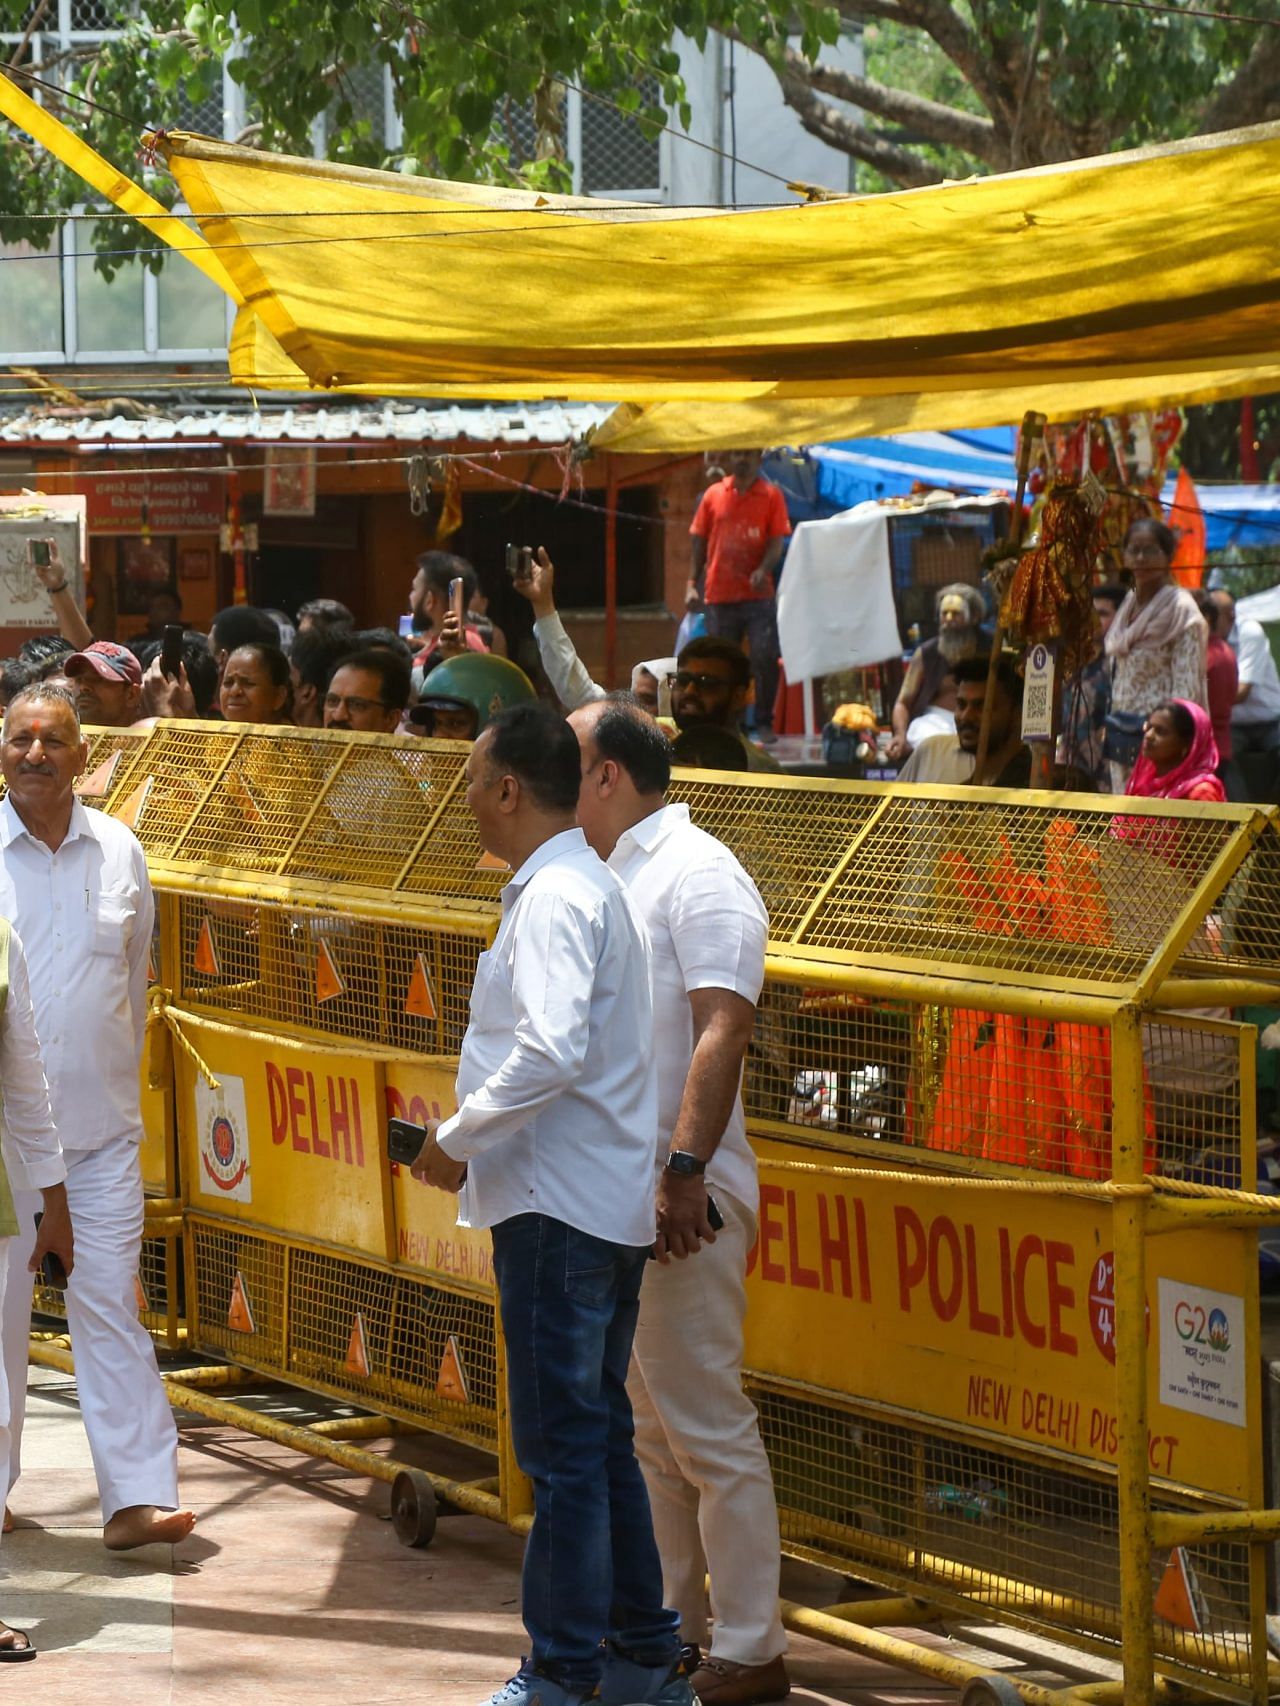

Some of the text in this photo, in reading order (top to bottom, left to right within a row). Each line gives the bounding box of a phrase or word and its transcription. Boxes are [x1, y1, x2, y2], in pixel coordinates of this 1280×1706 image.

[265, 1061, 365, 1168] DELHI
[399, 1228, 430, 1269] NEW
[435, 1237, 473, 1276] DELHI
[745, 1184, 872, 1304] ELHI
[894, 1205, 1078, 1357] POLICE
[967, 1375, 1012, 1426] NEW
[1021, 1388, 1080, 1449] DELHI
